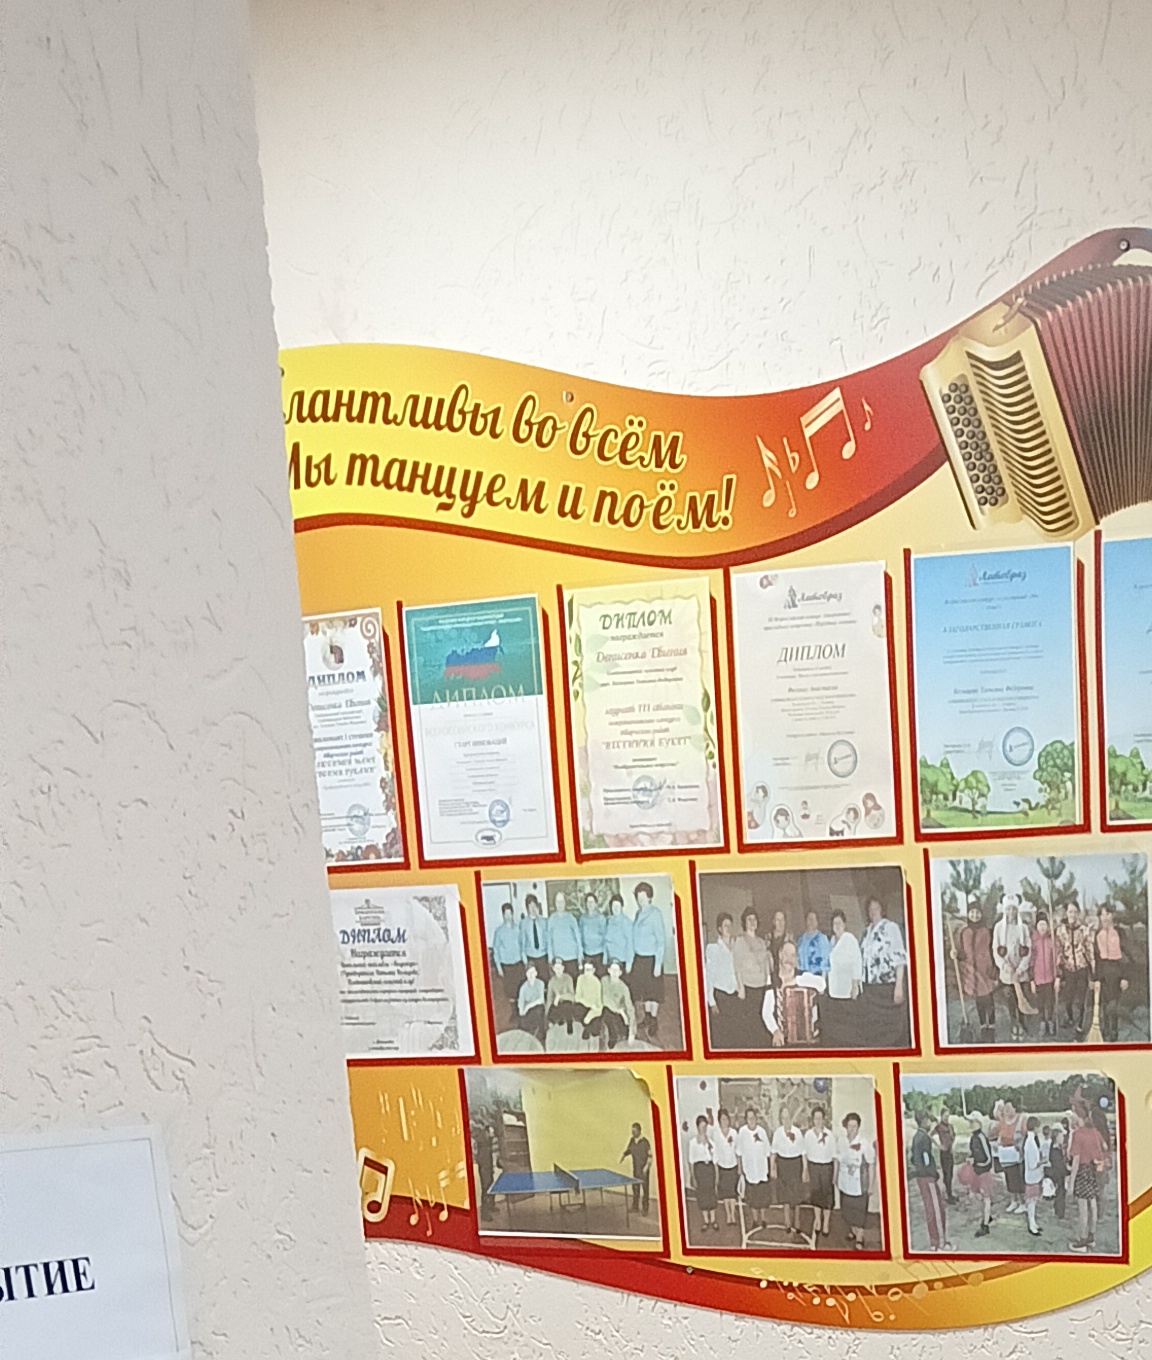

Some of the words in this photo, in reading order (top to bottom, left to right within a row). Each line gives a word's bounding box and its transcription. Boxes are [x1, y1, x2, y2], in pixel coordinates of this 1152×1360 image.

[284, 384, 504, 440] лантливы
[512, 394, 566, 449] во
[569, 407, 685, 470] всём
[345, 452, 549, 519] танцуем
[557, 485, 586, 520] и
[593, 477, 734, 531] поём!
[599, 608, 673, 631] ДИПЛОМ
[777, 643, 846, 665] ДИПЛОМ
[308, 670, 367, 690] ДИПЛОМ
[430, 683, 526, 711] ДИПЛОМ
[339, 927, 408, 946] ДИПЛОМ
